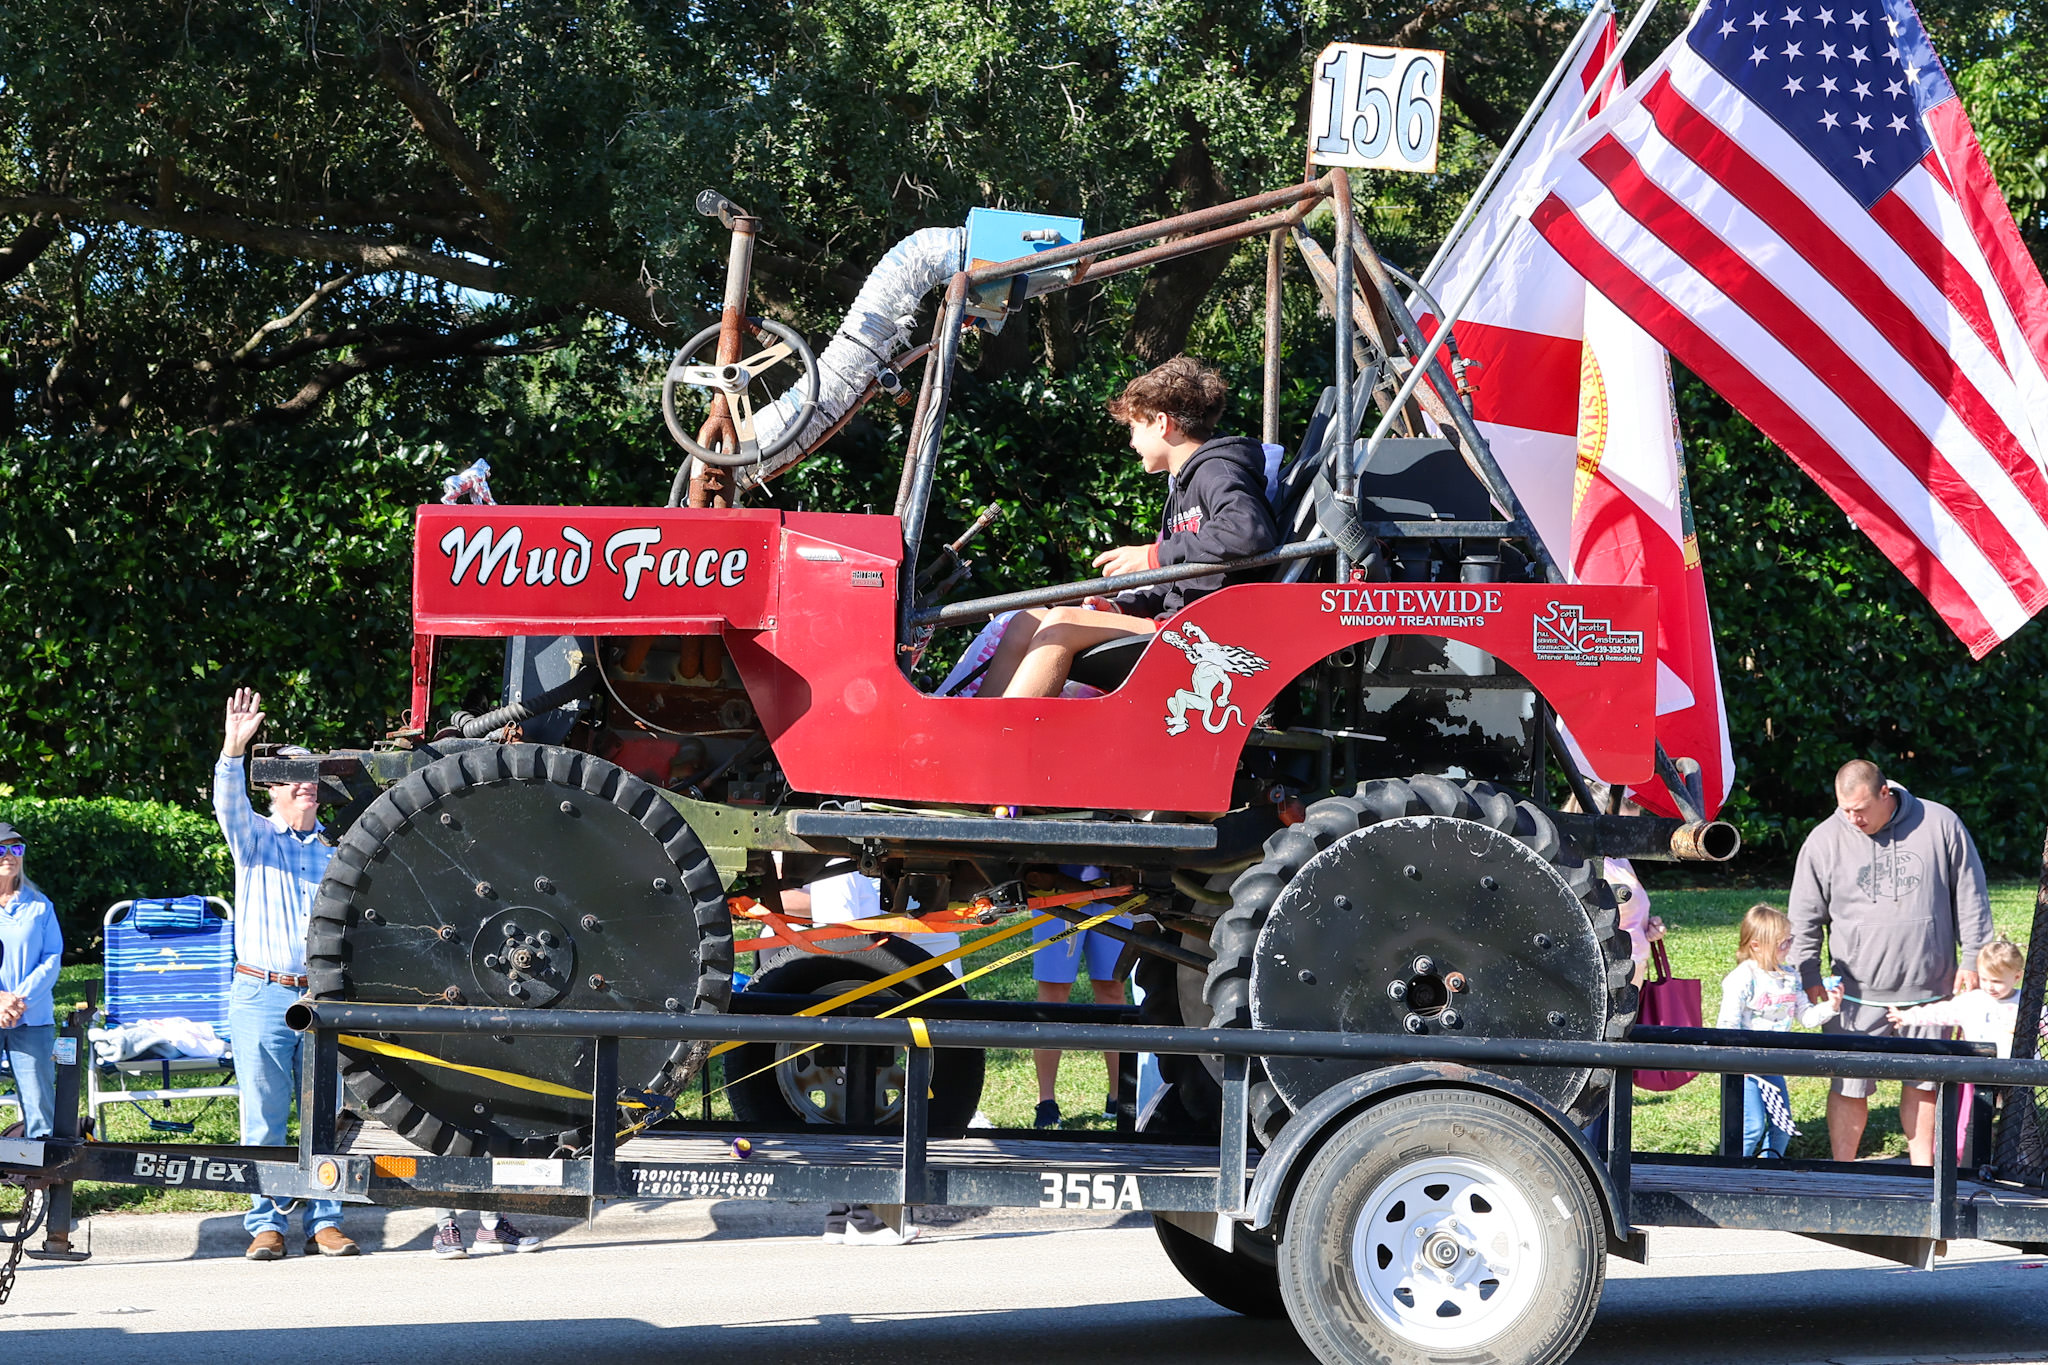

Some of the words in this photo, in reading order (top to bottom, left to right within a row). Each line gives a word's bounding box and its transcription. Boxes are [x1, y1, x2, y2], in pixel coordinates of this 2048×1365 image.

[1317, 50, 1437, 163] 156
[1579, 395, 1599, 471] STATE
[440, 526, 592, 587] Mud
[604, 526, 748, 601] Face
[1320, 589, 1503, 613] STATEWIDE
[1541, 600, 1577, 622] Scott
[1340, 615, 1396, 626] WINDOW
[1399, 615, 1485, 627] TREATMENTS
[1560, 618, 1605, 645] Marcotte
[1578, 633, 1638, 653] Construction
[1594, 645, 1639, 654] 239-352-6767
[1605, 654, 1642, 663] Remodeling
[632, 1168, 774, 1186] TROPICTRAILER.COM
[637, 1182, 768, 1197] 1-800-897-4430
[1040, 1172, 1144, 1211] 35SA
